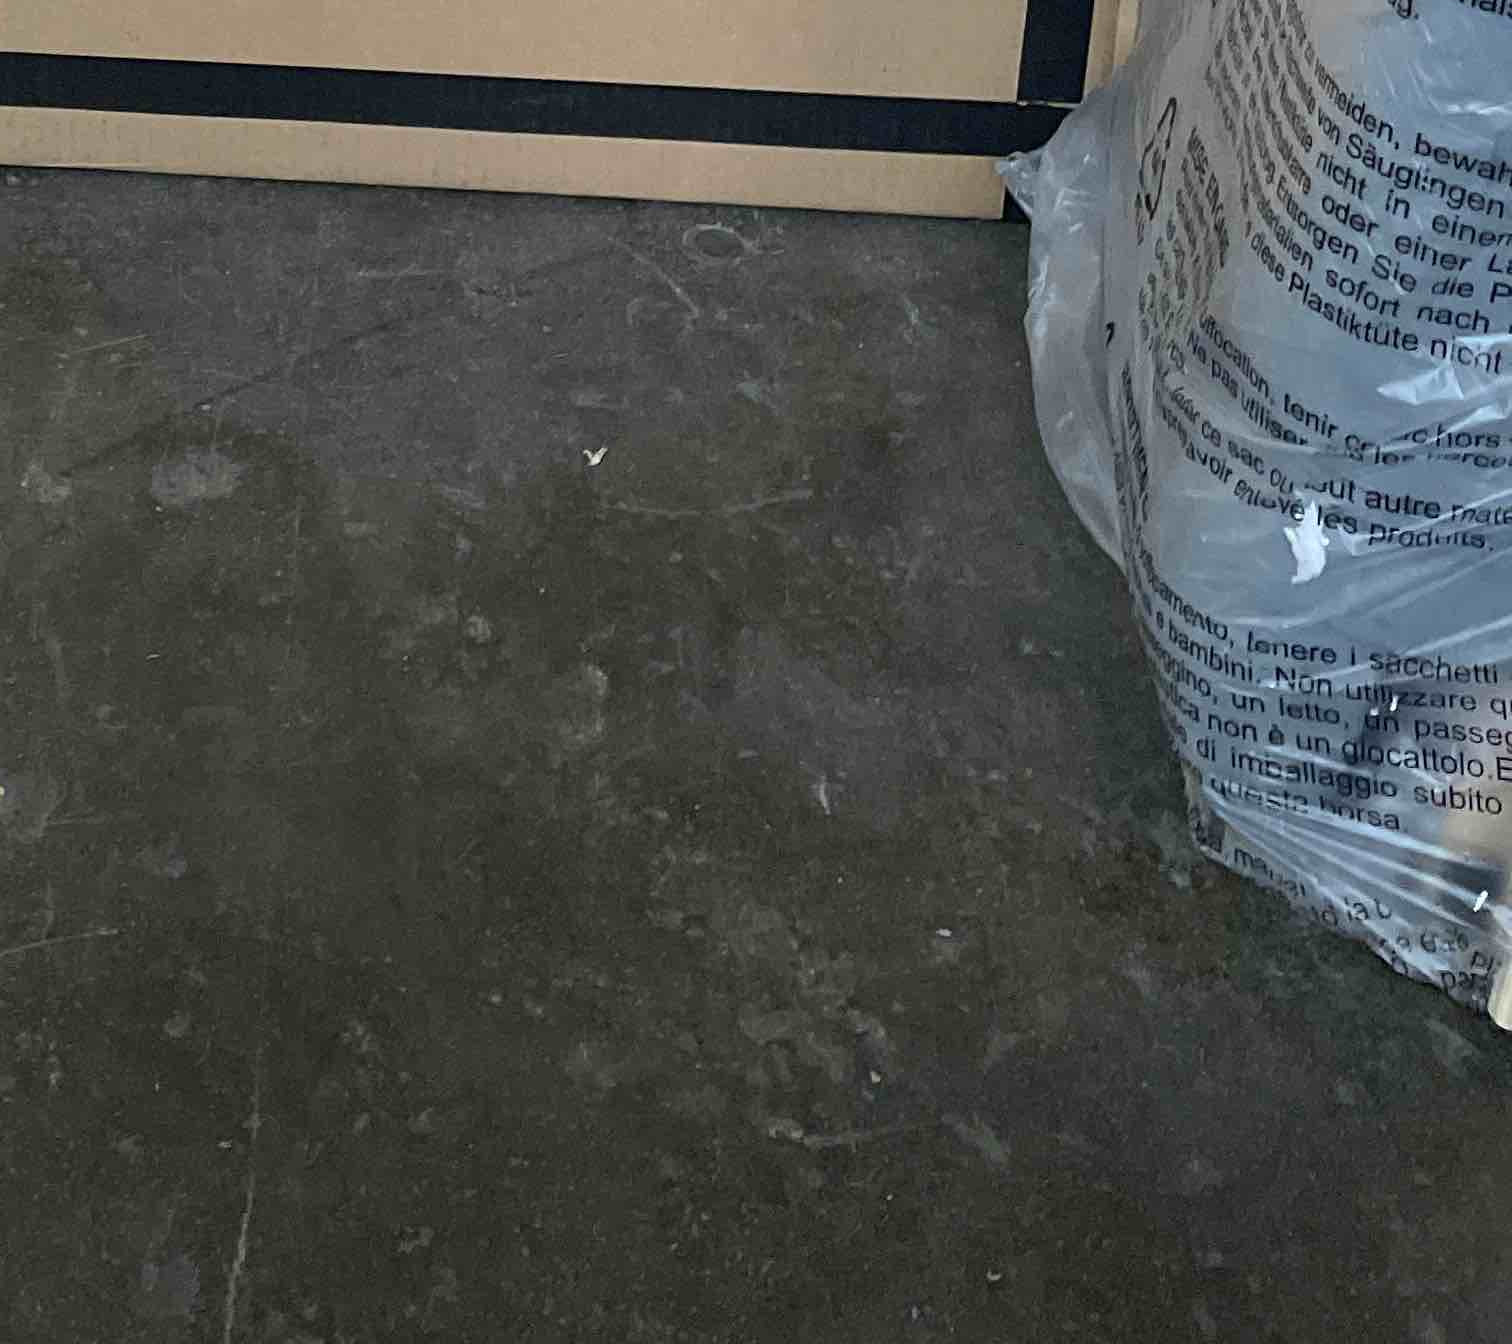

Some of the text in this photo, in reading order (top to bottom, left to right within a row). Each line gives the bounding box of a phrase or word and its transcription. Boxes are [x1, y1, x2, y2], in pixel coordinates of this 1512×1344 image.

[1317, 109, 1341, 145] von
[1315, 151, 1368, 201] nicht
[1385, 188, 1411, 219] in
[1321, 194, 1380, 238] oder
[1394, 234, 1473, 271] einer
[1370, 253, 1417, 293] Sie
[1431, 280, 1475, 299] die
[1324, 268, 1491, 335] sofort nach
[1430, 335, 1503, 375] nicht
[1316, 505, 1359, 536] les
[1364, 489, 1441, 520] autre
[1247, 630, 1499, 686] tenere sacchetti
[1231, 691, 1265, 713] un
[1274, 665, 1333, 699] Non
[1345, 682, 1478, 712] utilizzare
[1207, 712, 1258, 743] non
[1295, 732, 1331, 754] un
[1195, 734, 1503, 816] di imballaggio subito
